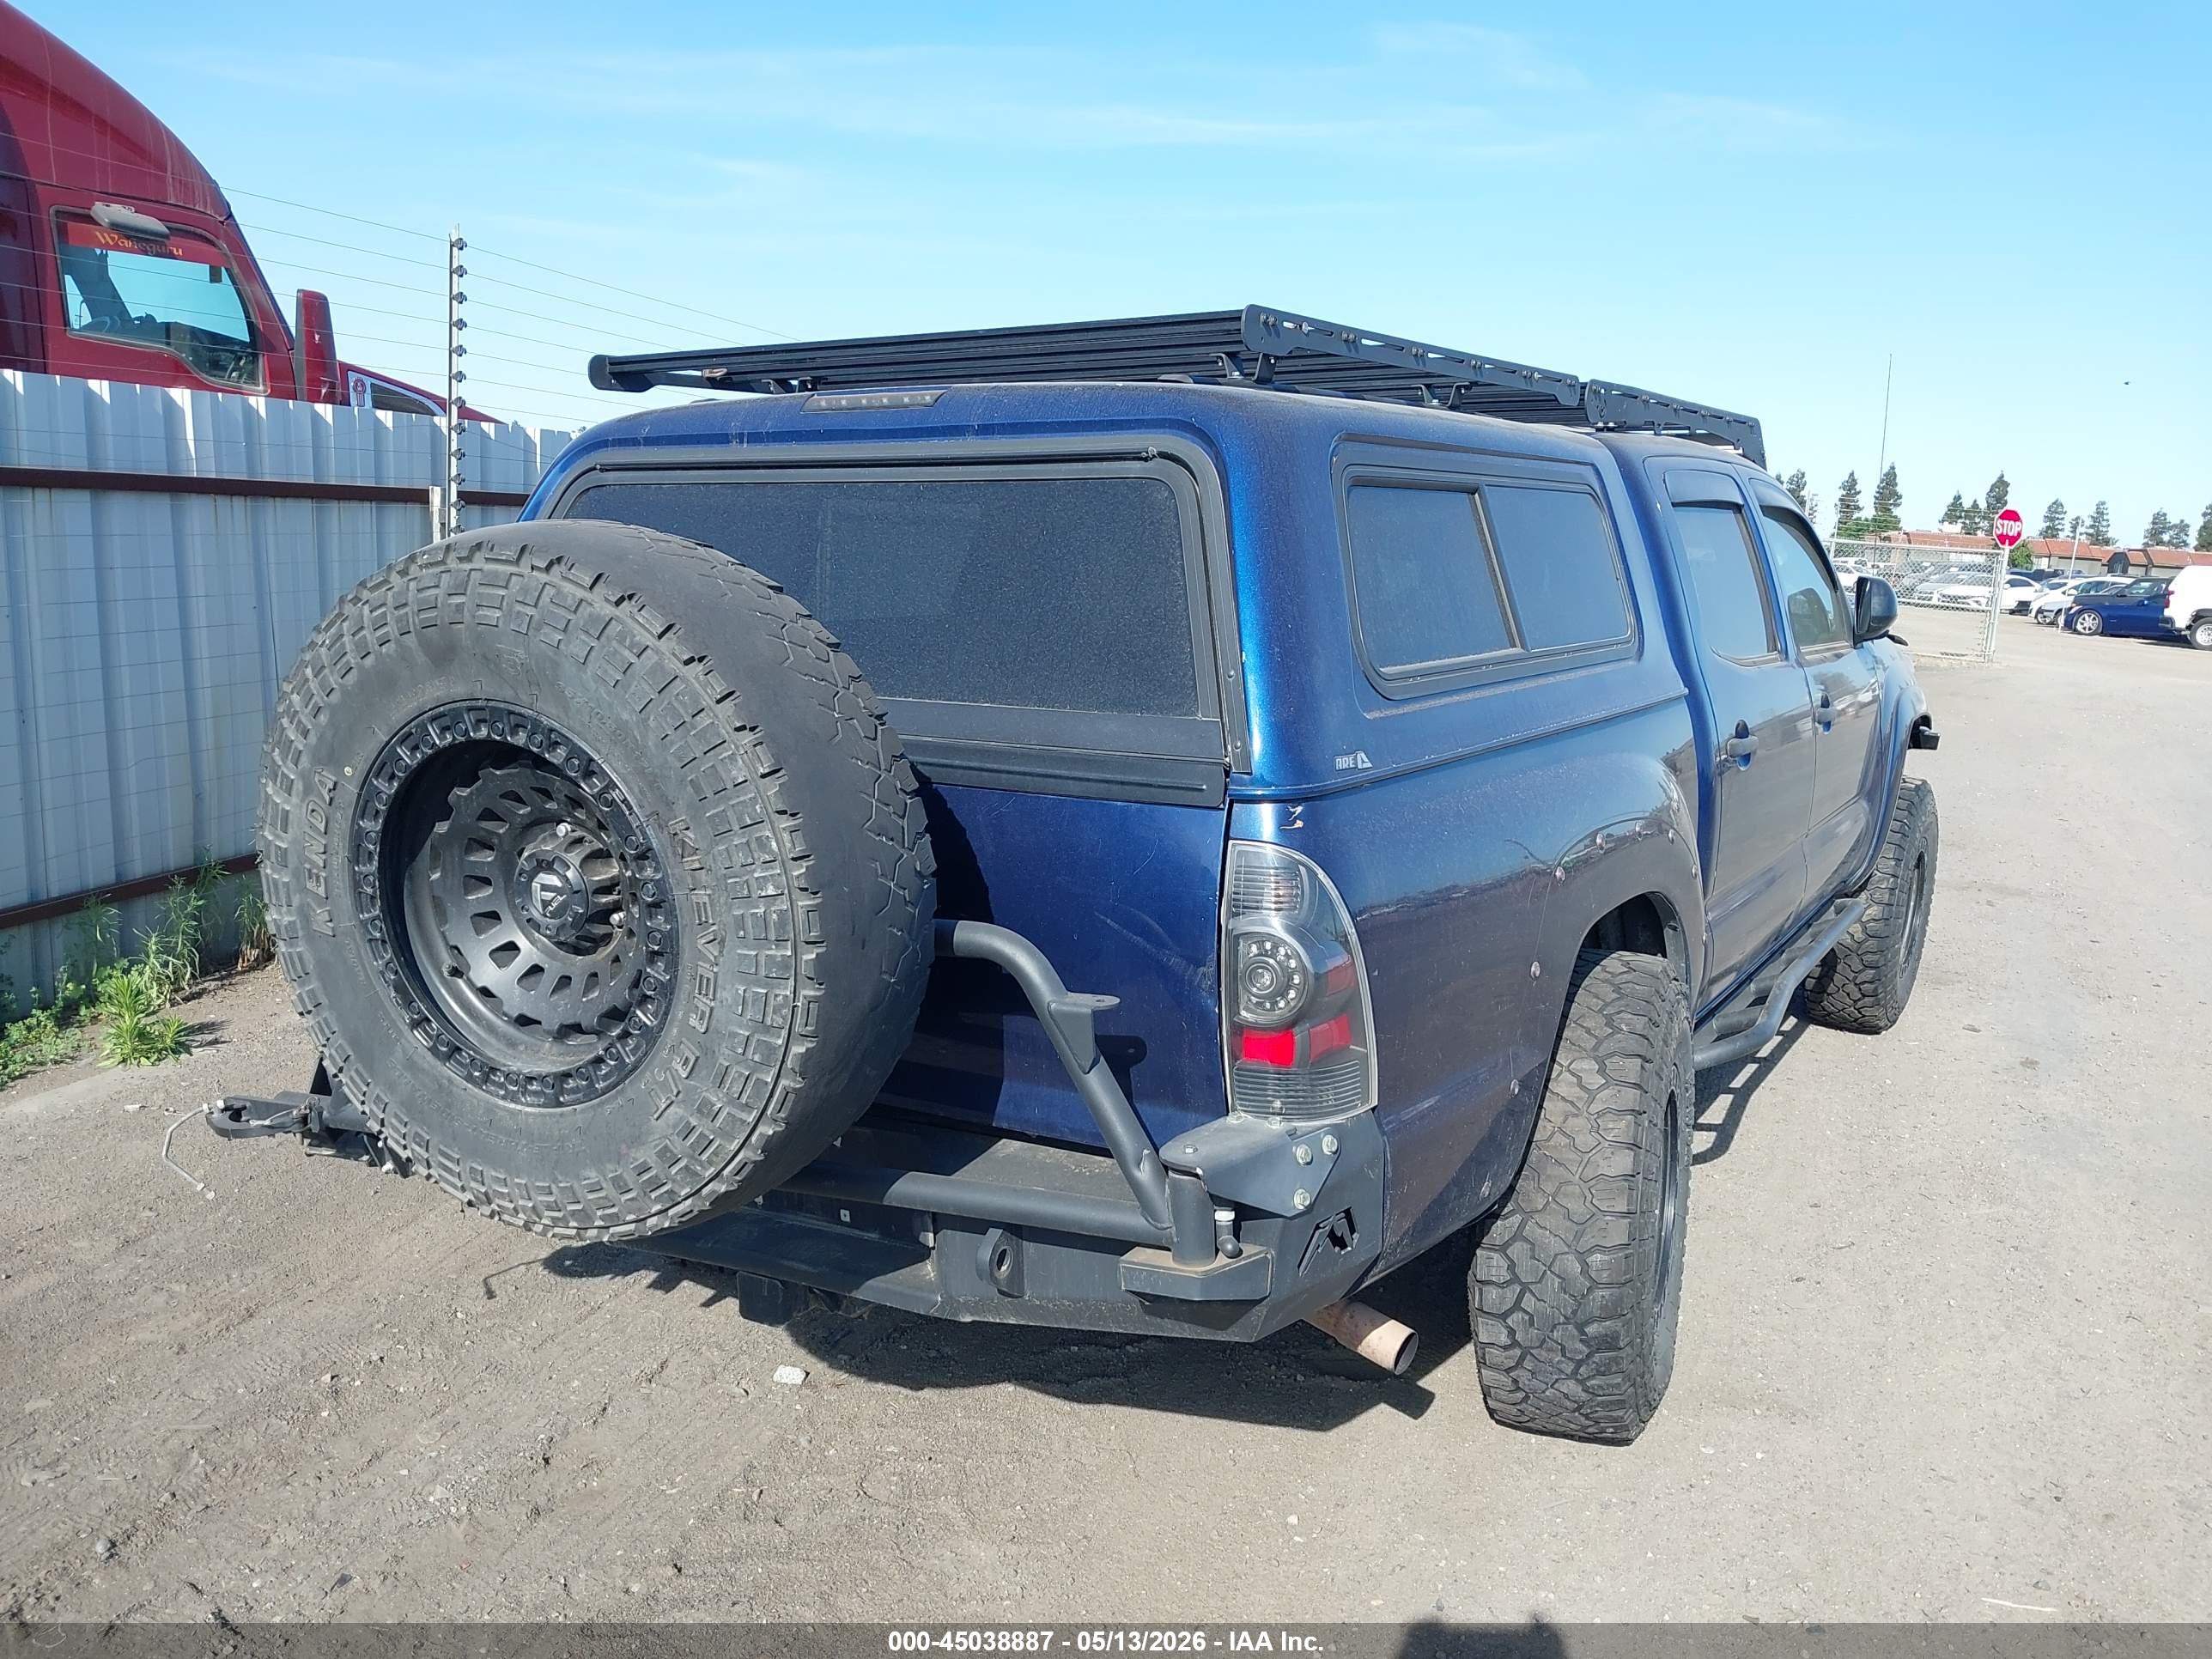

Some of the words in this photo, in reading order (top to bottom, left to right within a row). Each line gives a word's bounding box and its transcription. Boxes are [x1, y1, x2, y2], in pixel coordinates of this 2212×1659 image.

[1995, 519, 2022, 537] STOP
[302, 768, 337, 939] KENDA
[543, 894, 568, 918] FUEL
[667, 817, 718, 1034] KLEVER
[644, 1039, 700, 1121] R/T
